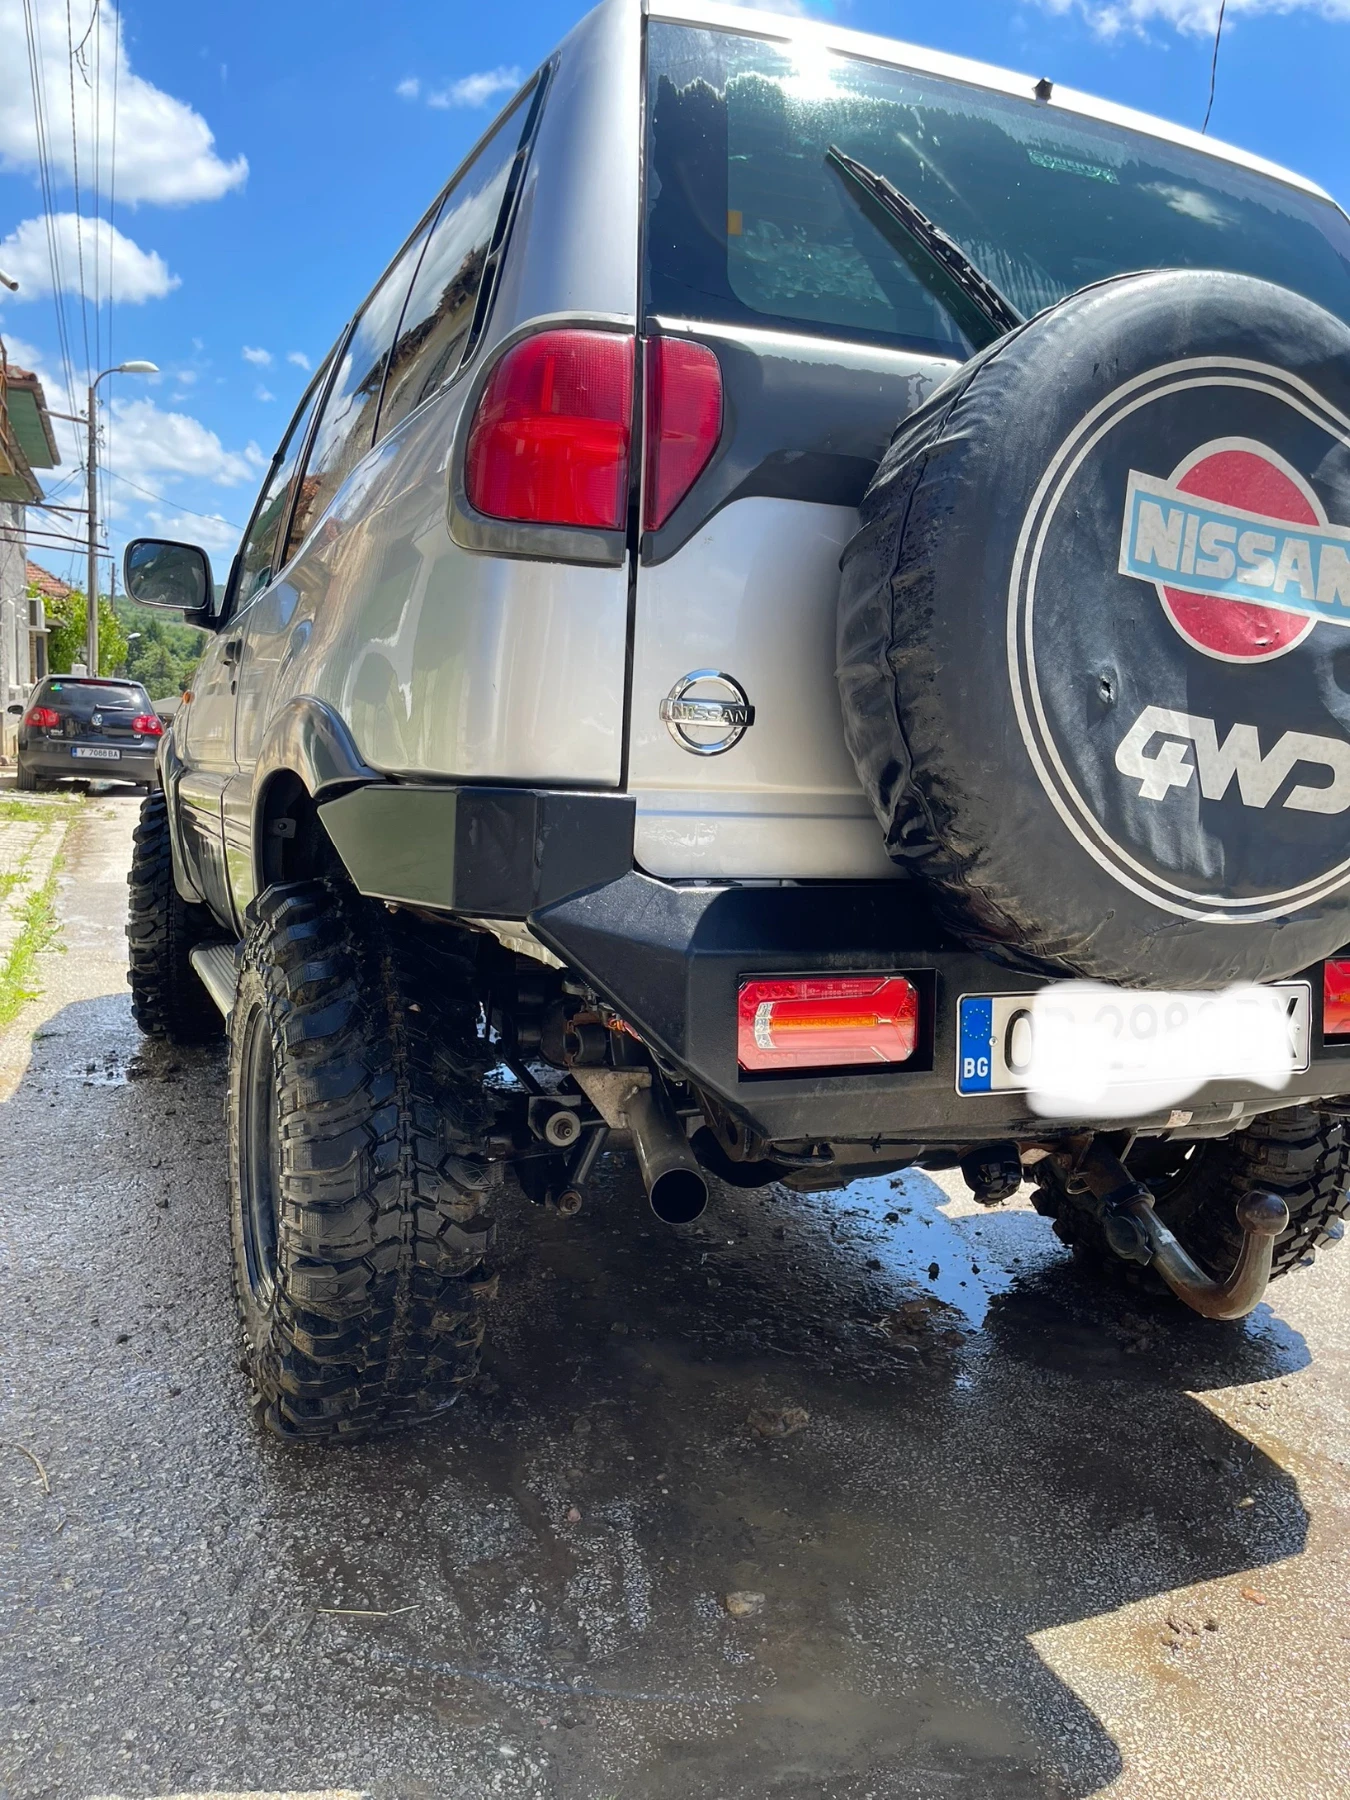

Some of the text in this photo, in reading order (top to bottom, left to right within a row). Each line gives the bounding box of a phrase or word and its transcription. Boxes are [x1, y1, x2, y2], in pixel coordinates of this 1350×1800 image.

[1133, 499, 1350, 606] NISSAN
[671, 704, 748, 723] NISSAN
[1115, 705, 1350, 815] 4WD
[963, 1056, 989, 1079] BG
